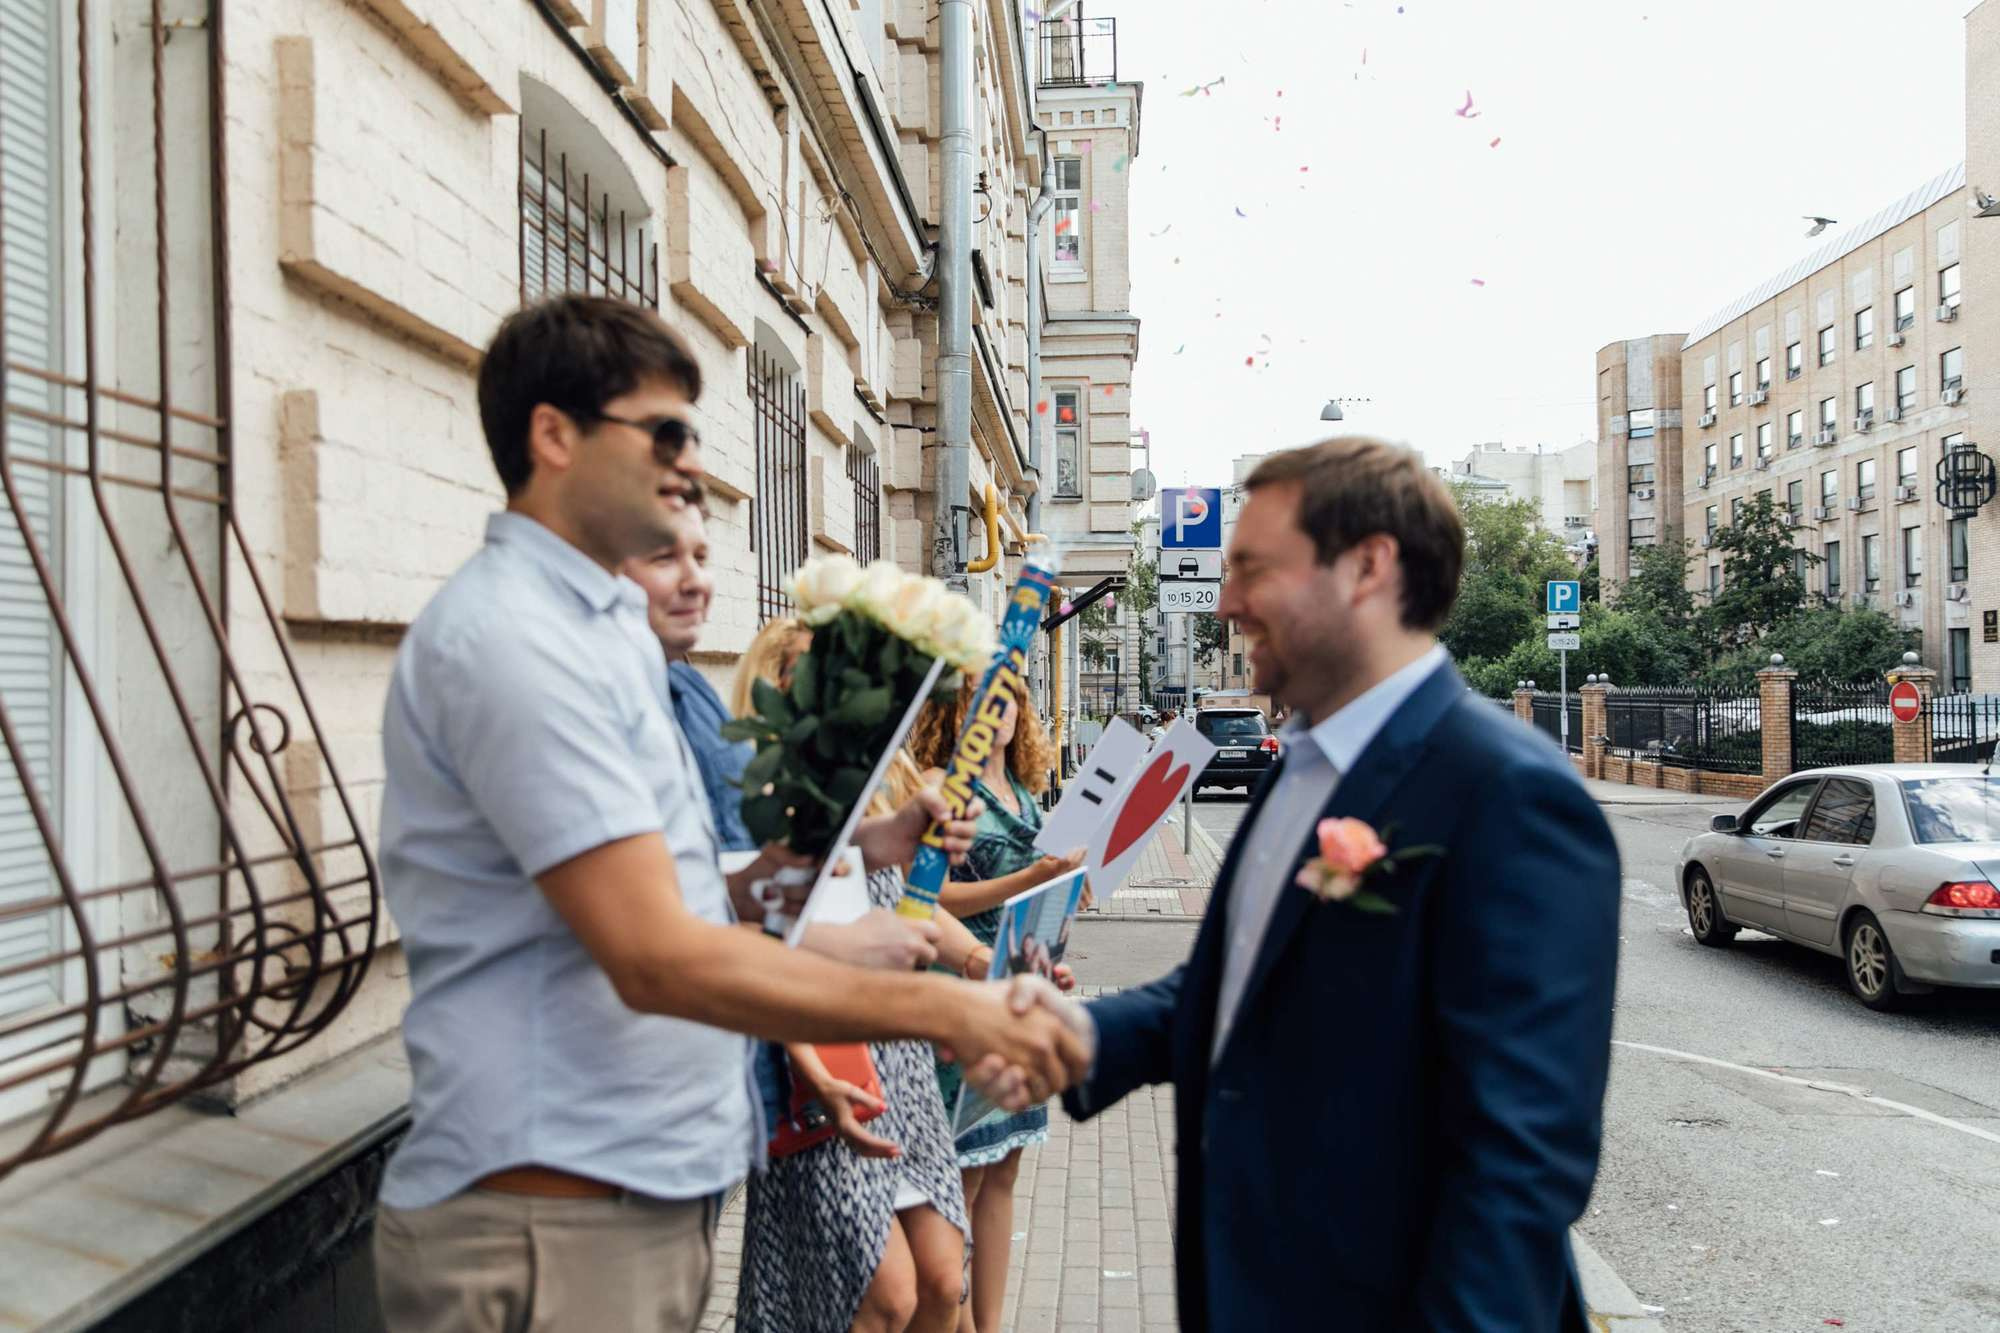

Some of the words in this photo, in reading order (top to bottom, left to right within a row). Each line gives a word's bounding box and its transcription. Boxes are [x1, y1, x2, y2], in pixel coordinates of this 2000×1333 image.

[1175, 495, 1209, 542] P
[1167, 593, 1177, 602] 10
[1180, 592, 1192, 603] 15
[1196, 591, 1214, 603] 20
[1555, 584, 1572, 609] P
